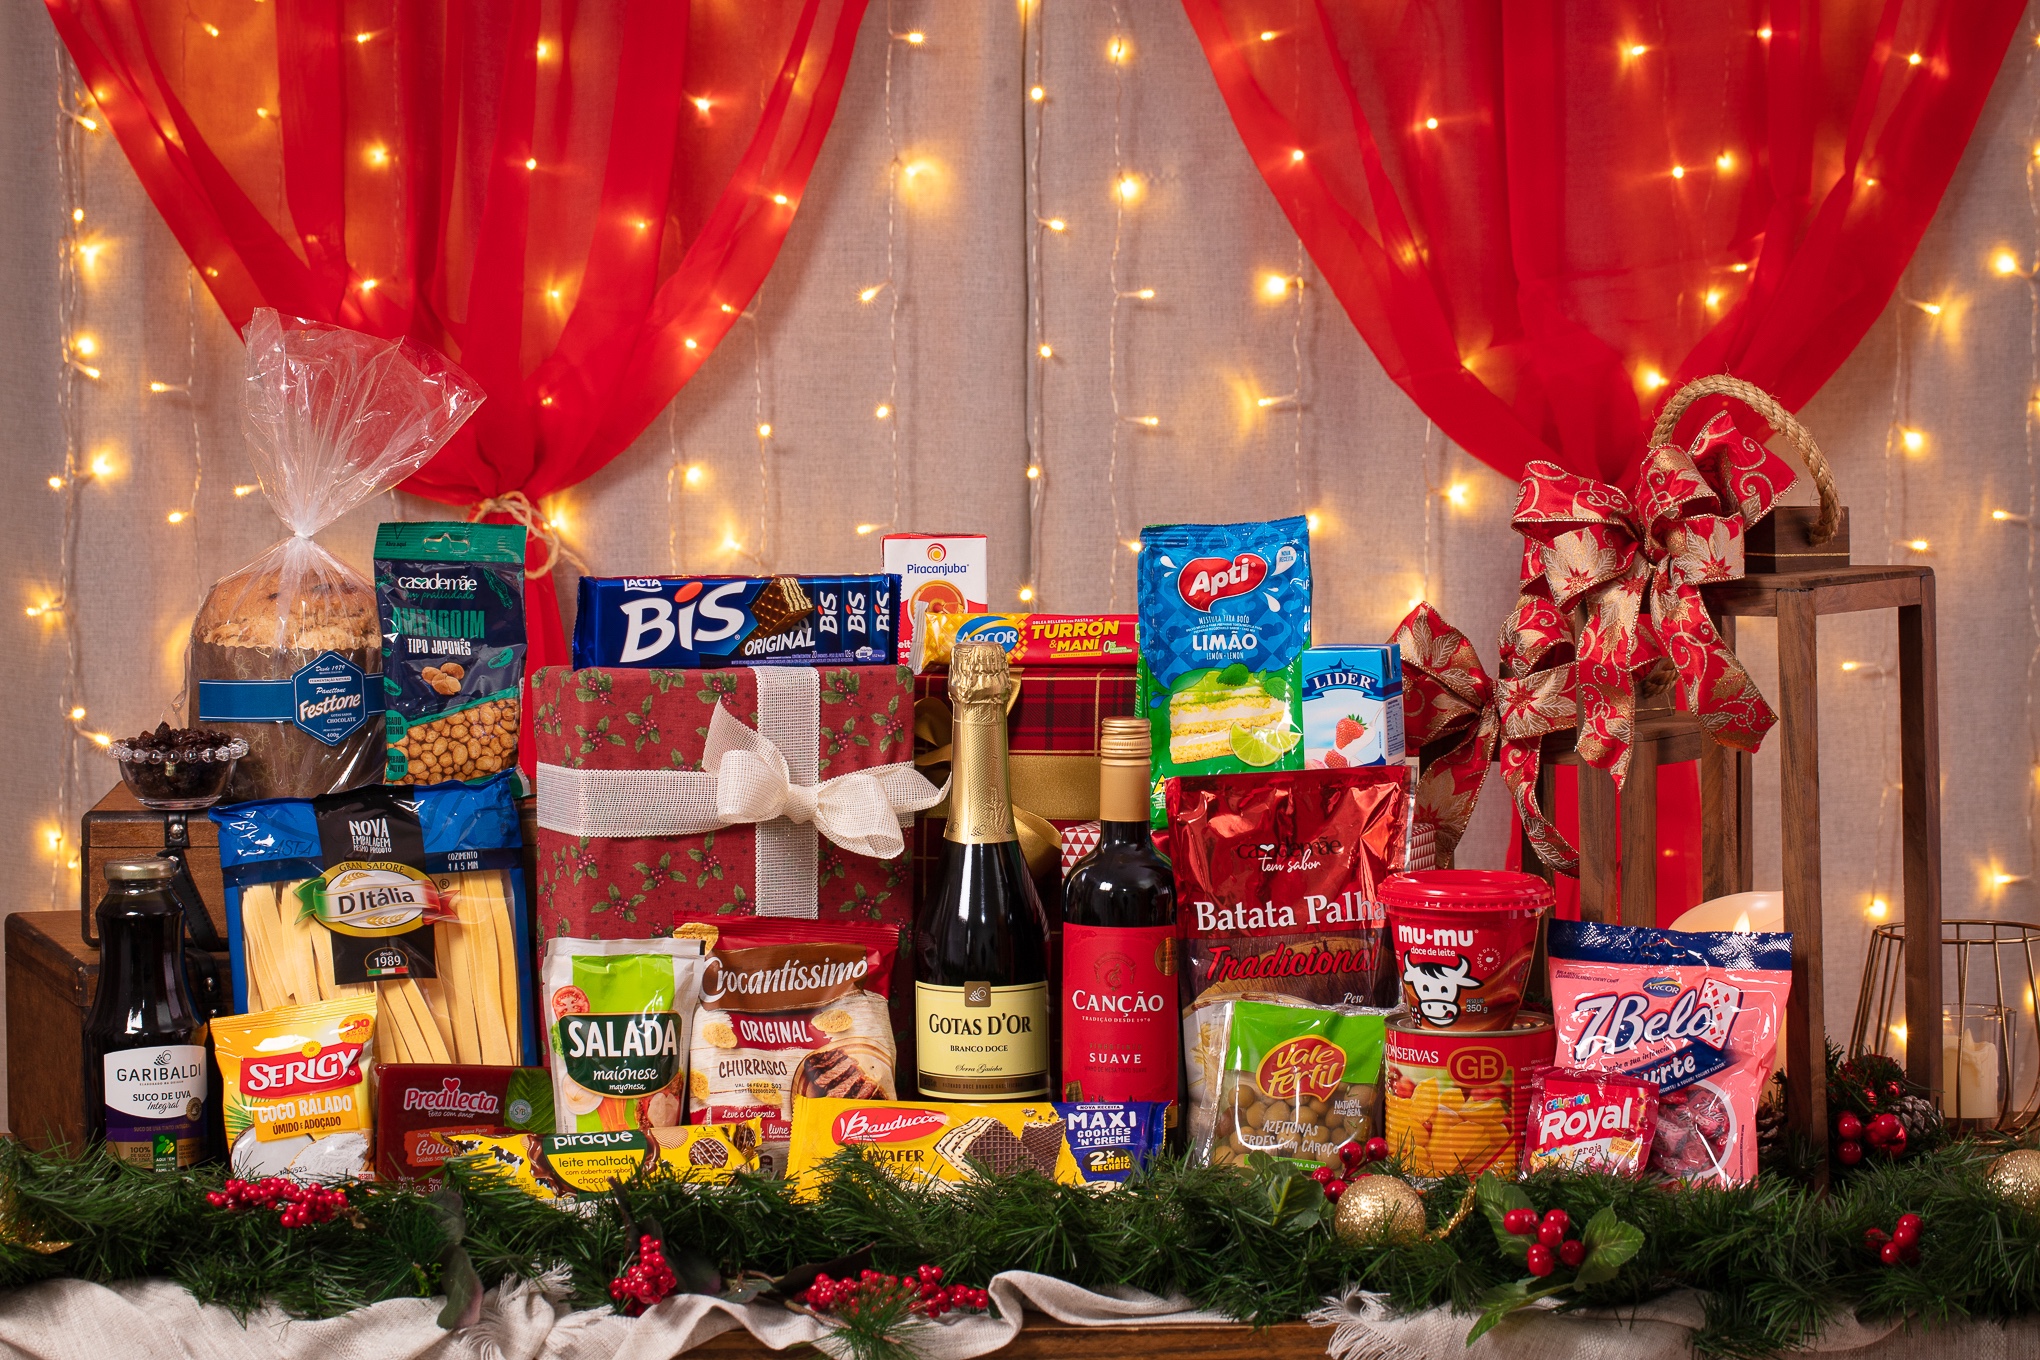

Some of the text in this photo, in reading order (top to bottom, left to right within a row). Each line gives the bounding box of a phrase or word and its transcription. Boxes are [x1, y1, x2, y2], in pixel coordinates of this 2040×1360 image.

[907, 564, 968, 576] Piracanjuba
[1188, 558, 1249, 596] Apti
[398, 573, 478, 591] casademãe
[623, 578, 663, 592] LACTA
[392, 607, 484, 638] AMENDOIM
[1198, 616, 1221, 624] MISTURA
[1031, 618, 1120, 640] TURRÓN
[408, 638, 472, 656] TIPO JAPONÊS
[744, 628, 816, 656] ORIGINAL
[1057, 635, 1101, 652] MANÍ
[1192, 630, 1258, 650] LIMÃO
[1206, 651, 1244, 660] LIMÓN LEMON
[1312, 672, 1372, 690] LIDER
[316, 687, 346, 695] Panettone
[299, 693, 361, 722] Festtone
[348, 818, 390, 838] NOVA
[352, 835, 390, 848] EMBALAGEM
[354, 845, 368, 853] MESMO
[448, 850, 478, 861] COZIMENTO
[1258, 849, 1322, 873] tem sabor
[339, 862, 404, 874] GRAN SAPORE
[454, 862, 458, 871] A
[460, 862, 465, 870] 5
[468, 860, 479, 870] MIN
[1194, 890, 1387, 931] Batata Palha
[1410, 946, 1426, 955] doce
[1438, 948, 1456, 956] leite
[374, 955, 401, 968] 1989
[1206, 943, 1380, 982] Tradicional
[700, 956, 868, 1003] Crocantíssimo
[1644, 982, 1680, 994] ARCOR
[1072, 990, 1164, 1017] CANÇÃO
[1344, 992, 1364, 1004] Peso
[740, 1020, 814, 1044] ORIGINAL
[929, 1014, 982, 1036] GOTAS
[568, 1020, 678, 1058] SALADA
[1090, 1042, 1113, 1050] VINHO
[986, 1044, 1008, 1052] DOCE
[1276, 1043, 1334, 1068] Vale
[1386, 1043, 1439, 1064] CONSERVAS
[1089, 1052, 1142, 1064] SUAVE
[1630, 1056, 1641, 1066] sua
[117, 1063, 201, 1082] GARIBALDI
[248, 1048, 359, 1091] SERIGY
[594, 1066, 658, 1081] maionese
[718, 1059, 788, 1078] CHURRASCO
[955, 1064, 976, 1072] Serra
[1456, 1055, 1498, 1080] GB
[1643, 1055, 1696, 1084] urte
[609, 1082, 646, 1094] mayonesa
[132, 1090, 191, 1102] SUCO DE UVA
[404, 1087, 498, 1114] Predilecta
[147, 1100, 180, 1114] Integral
[258, 1094, 352, 1124] COCO RALADO
[1334, 1099, 1362, 1110] NATURAL
[428, 1110, 442, 1118] Feito
[722, 1109, 738, 1118] Leve
[1068, 1111, 1136, 1130] MAXI
[272, 1121, 299, 1136] ÚMIDO
[304, 1116, 342, 1132] ADOÇADO
[768, 1124, 790, 1135] livre
[840, 1111, 940, 1141] Bauducco
[1263, 1120, 1318, 1137] AZEITONAS
[1540, 1098, 1632, 1146] Royal
[554, 1131, 633, 1150] piraquê
[1077, 1128, 1131, 1138] COOKIES
[1094, 1136, 1130, 1144] CREME
[416, 1140, 450, 1156] Goia
[1572, 1144, 1602, 1157] cereja
[558, 1155, 636, 1168] leite maltado
[866, 1150, 924, 1162] WAFER
[1106, 1156, 1130, 1164] MAIS
[1091, 1163, 1131, 1172] RECHEIO
[578, 1176, 610, 1184] chocol
